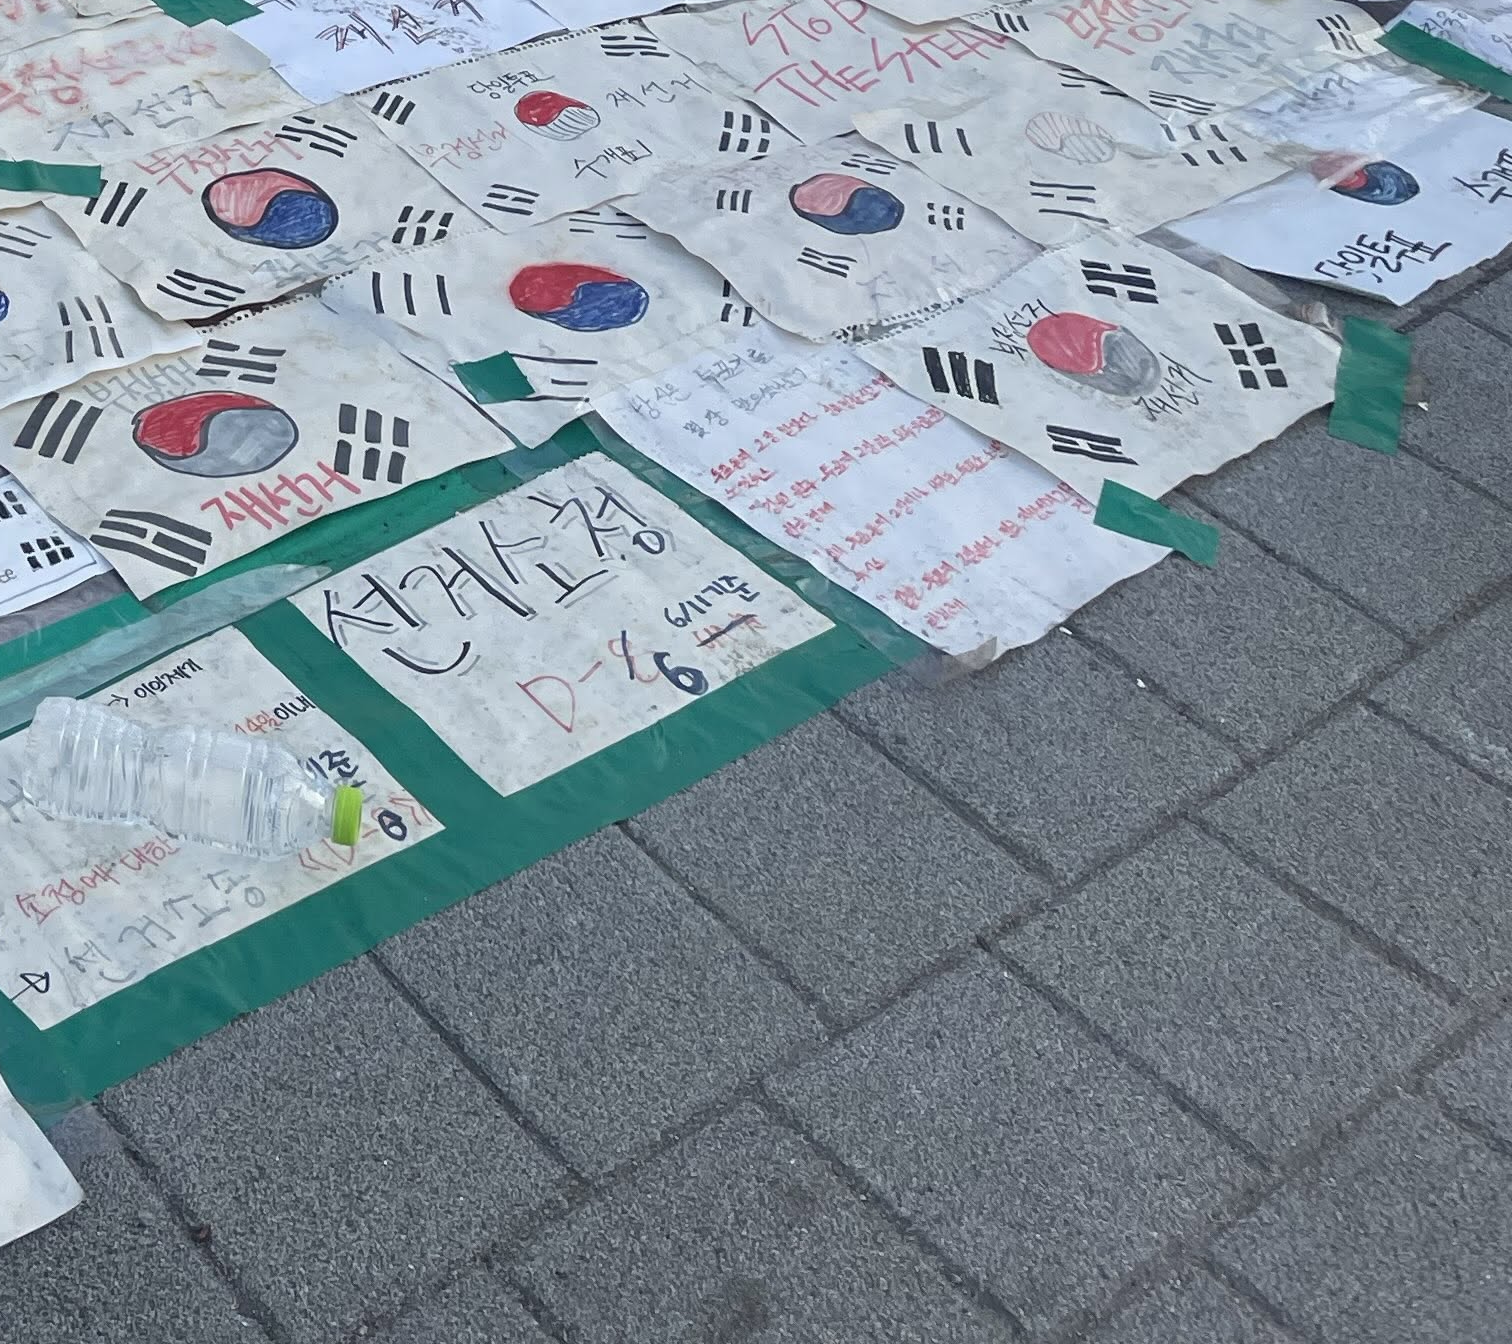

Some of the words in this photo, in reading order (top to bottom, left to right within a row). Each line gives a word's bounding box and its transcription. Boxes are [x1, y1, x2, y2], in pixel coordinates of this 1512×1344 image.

[753, 58, 873, 108] THE
[876, 12, 1011, 85] STEAL
[135, 128, 307, 196] 부정선거
[200, 460, 362, 533] 재선거
